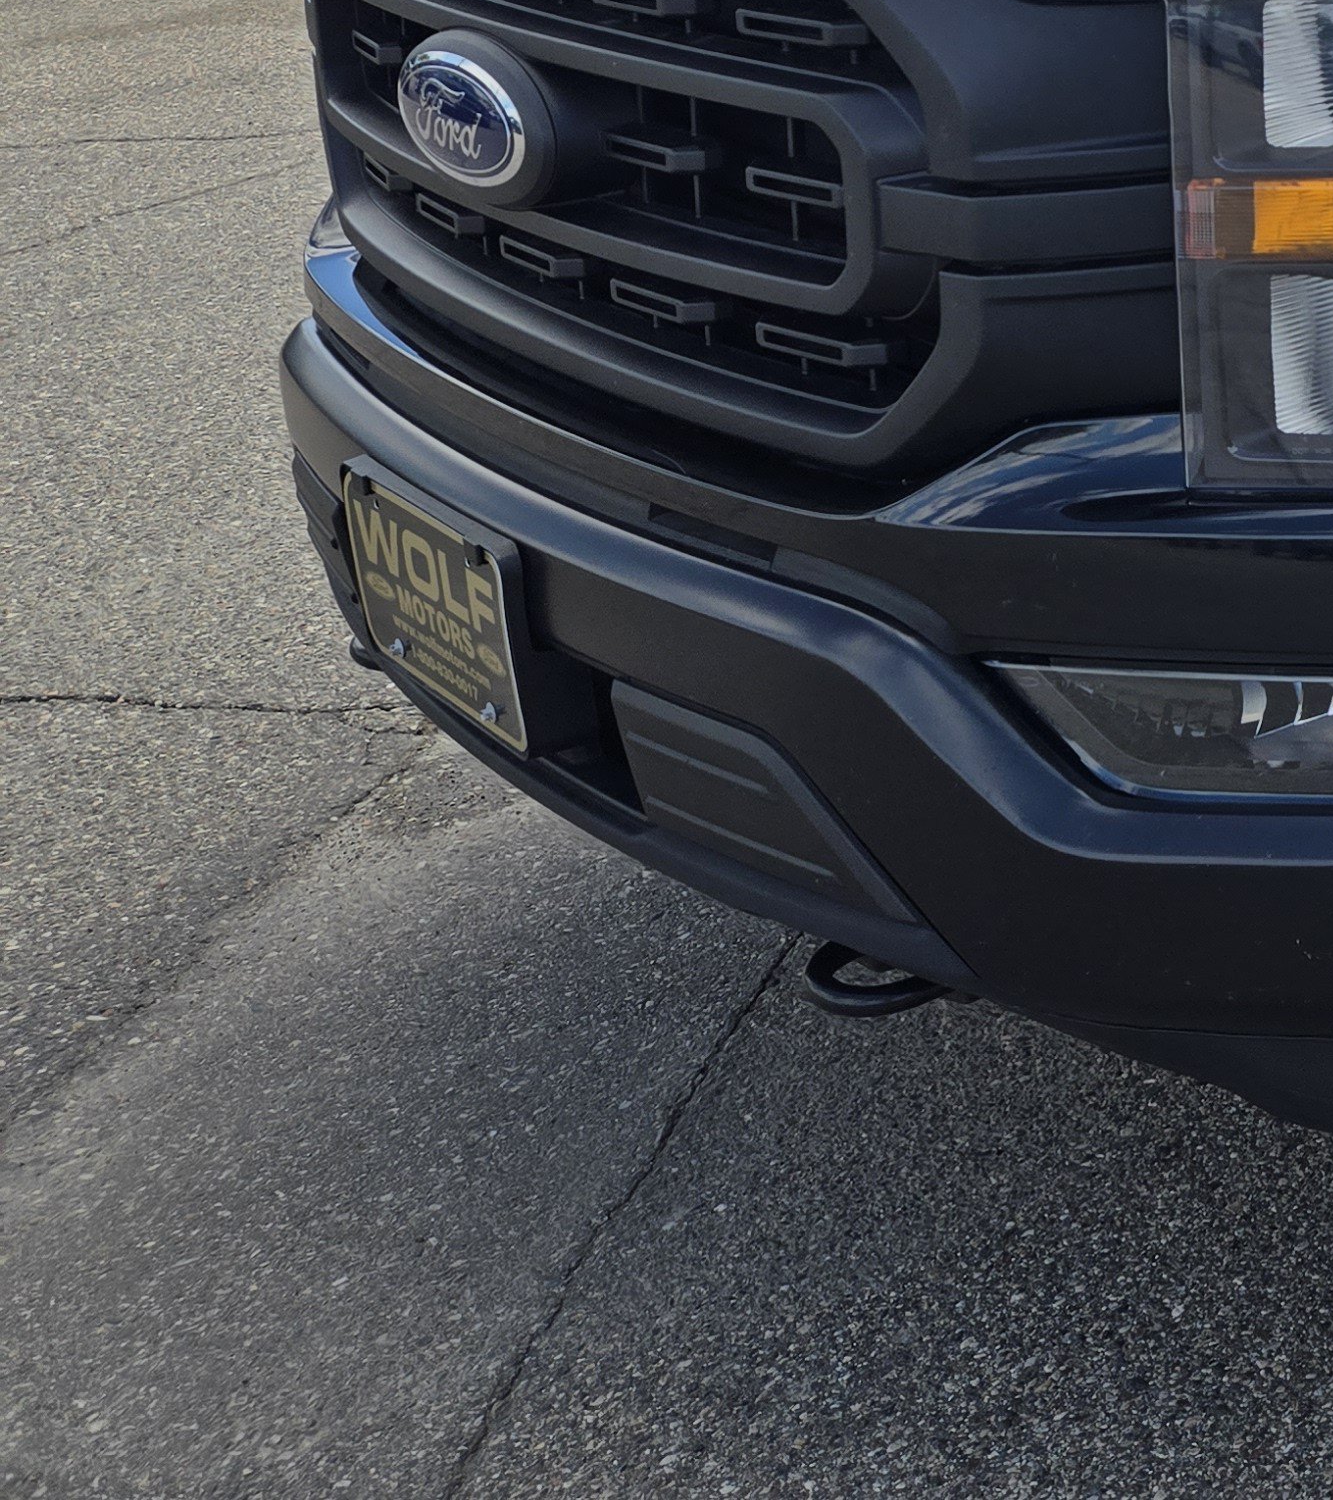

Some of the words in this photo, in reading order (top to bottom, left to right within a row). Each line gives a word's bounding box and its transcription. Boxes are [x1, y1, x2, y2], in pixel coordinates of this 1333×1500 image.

[415, 77, 482, 160] Ford
[352, 498, 497, 634] WOLF
[394, 583, 477, 660] MOTORS
